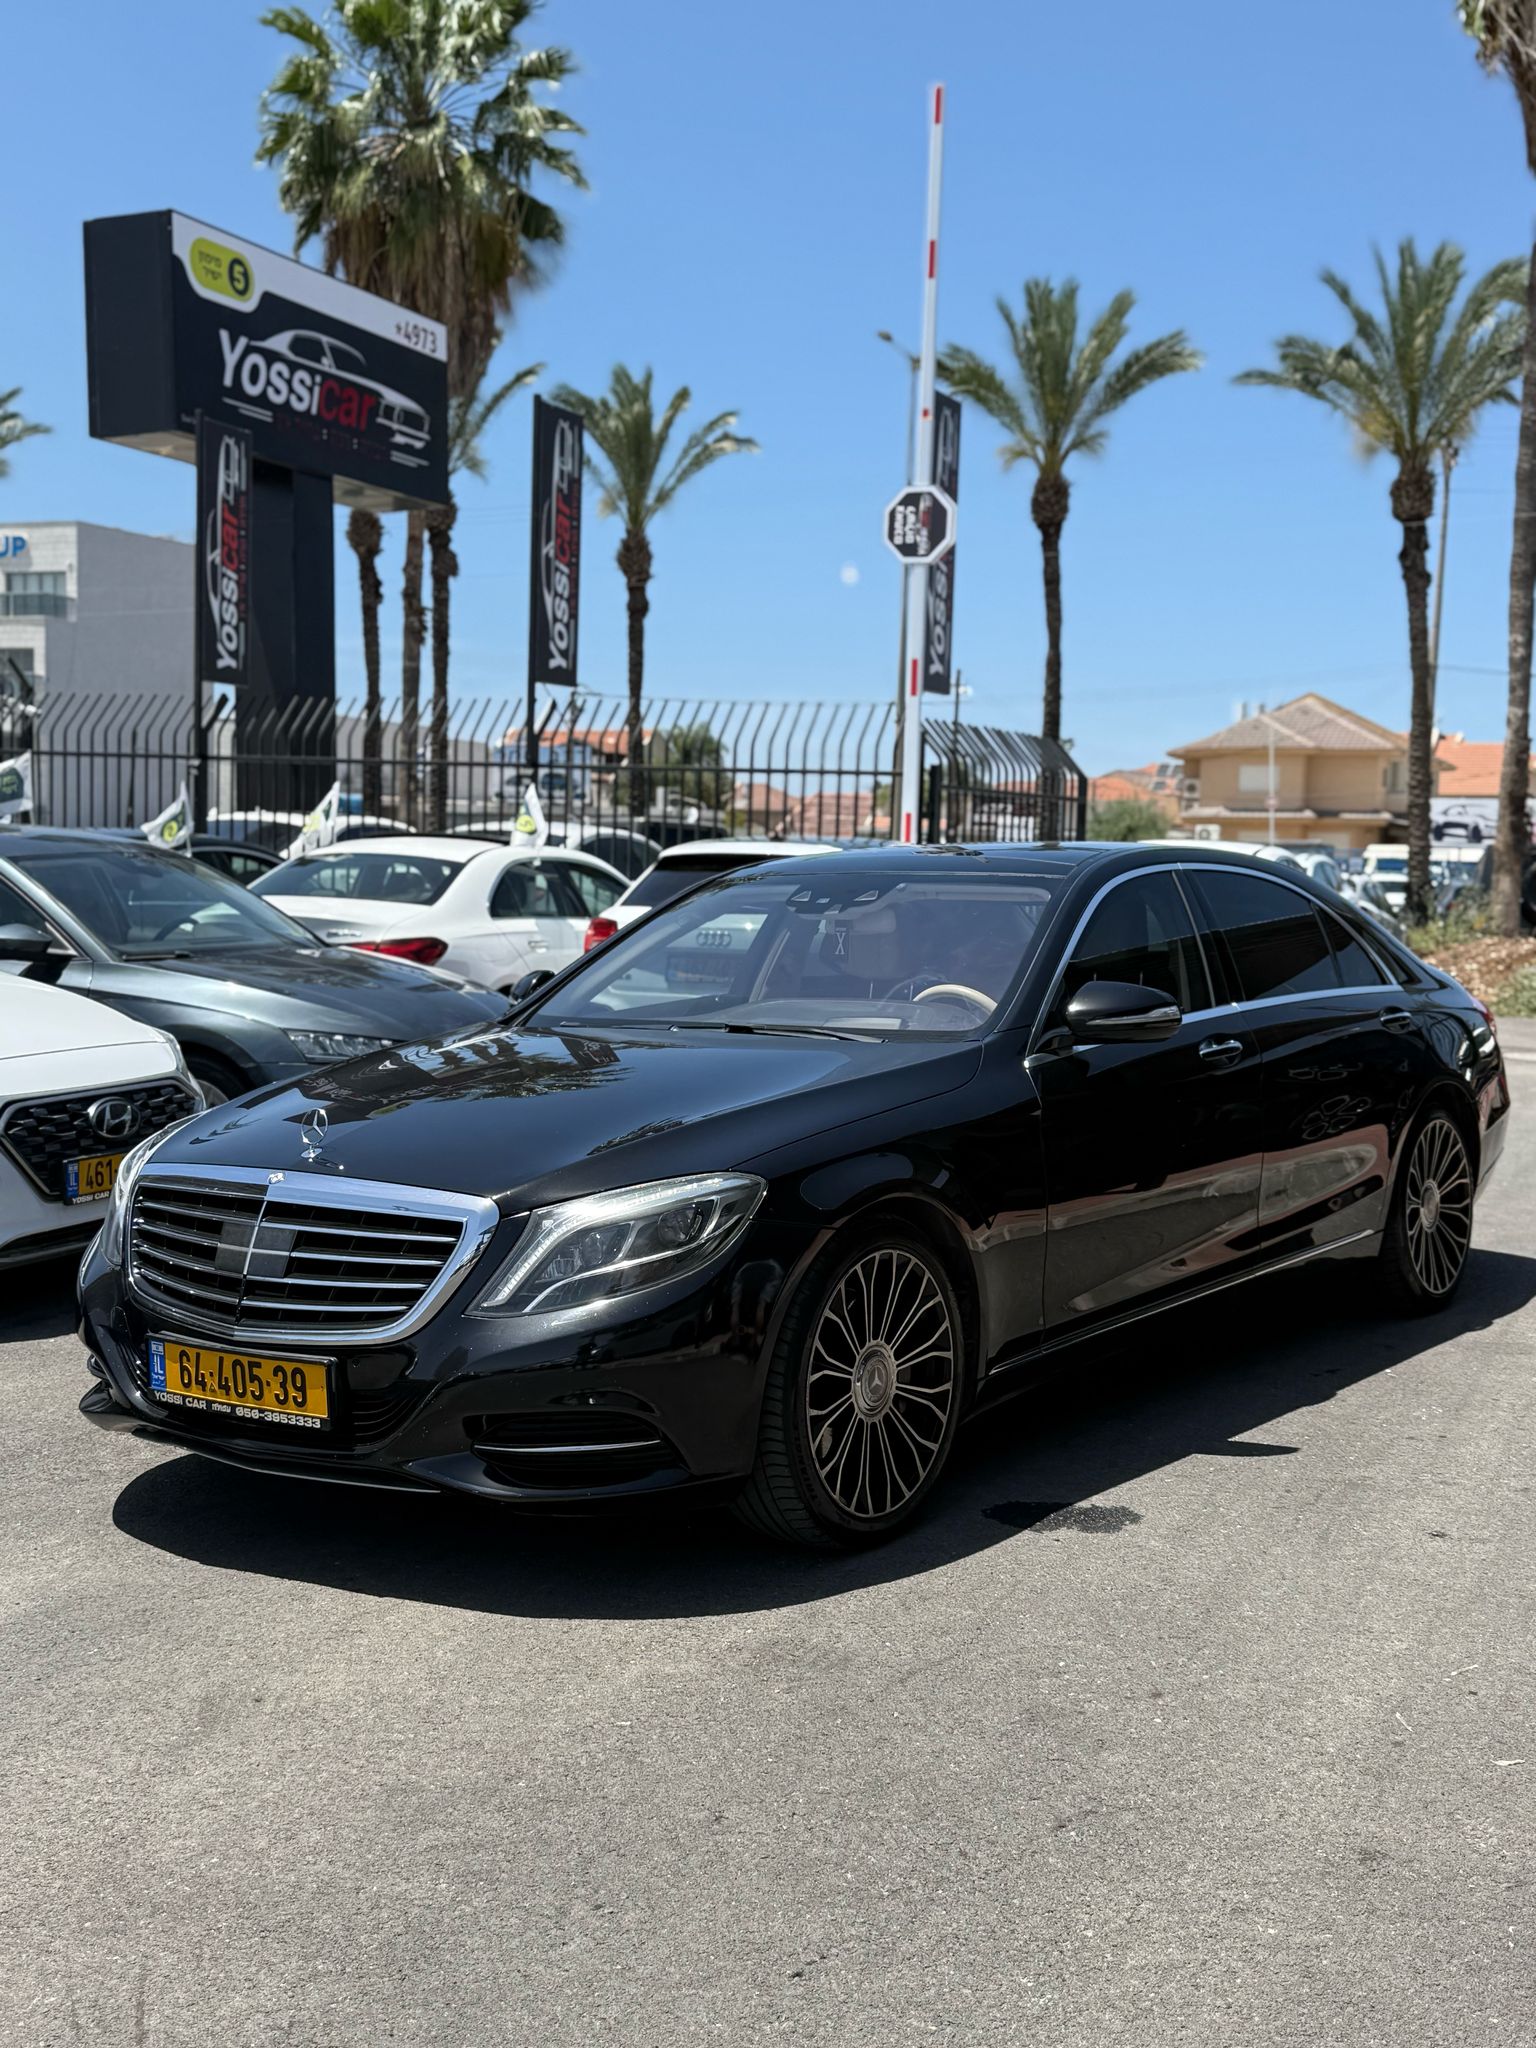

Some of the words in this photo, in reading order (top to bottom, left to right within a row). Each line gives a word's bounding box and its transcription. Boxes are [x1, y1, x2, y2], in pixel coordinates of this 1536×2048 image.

[95, 1190, 109, 1200] CAR
[154, 1354, 164, 1373] IL
[154, 1390, 183, 1405] YOSSI
[185, 1397, 207, 1410] CAR
